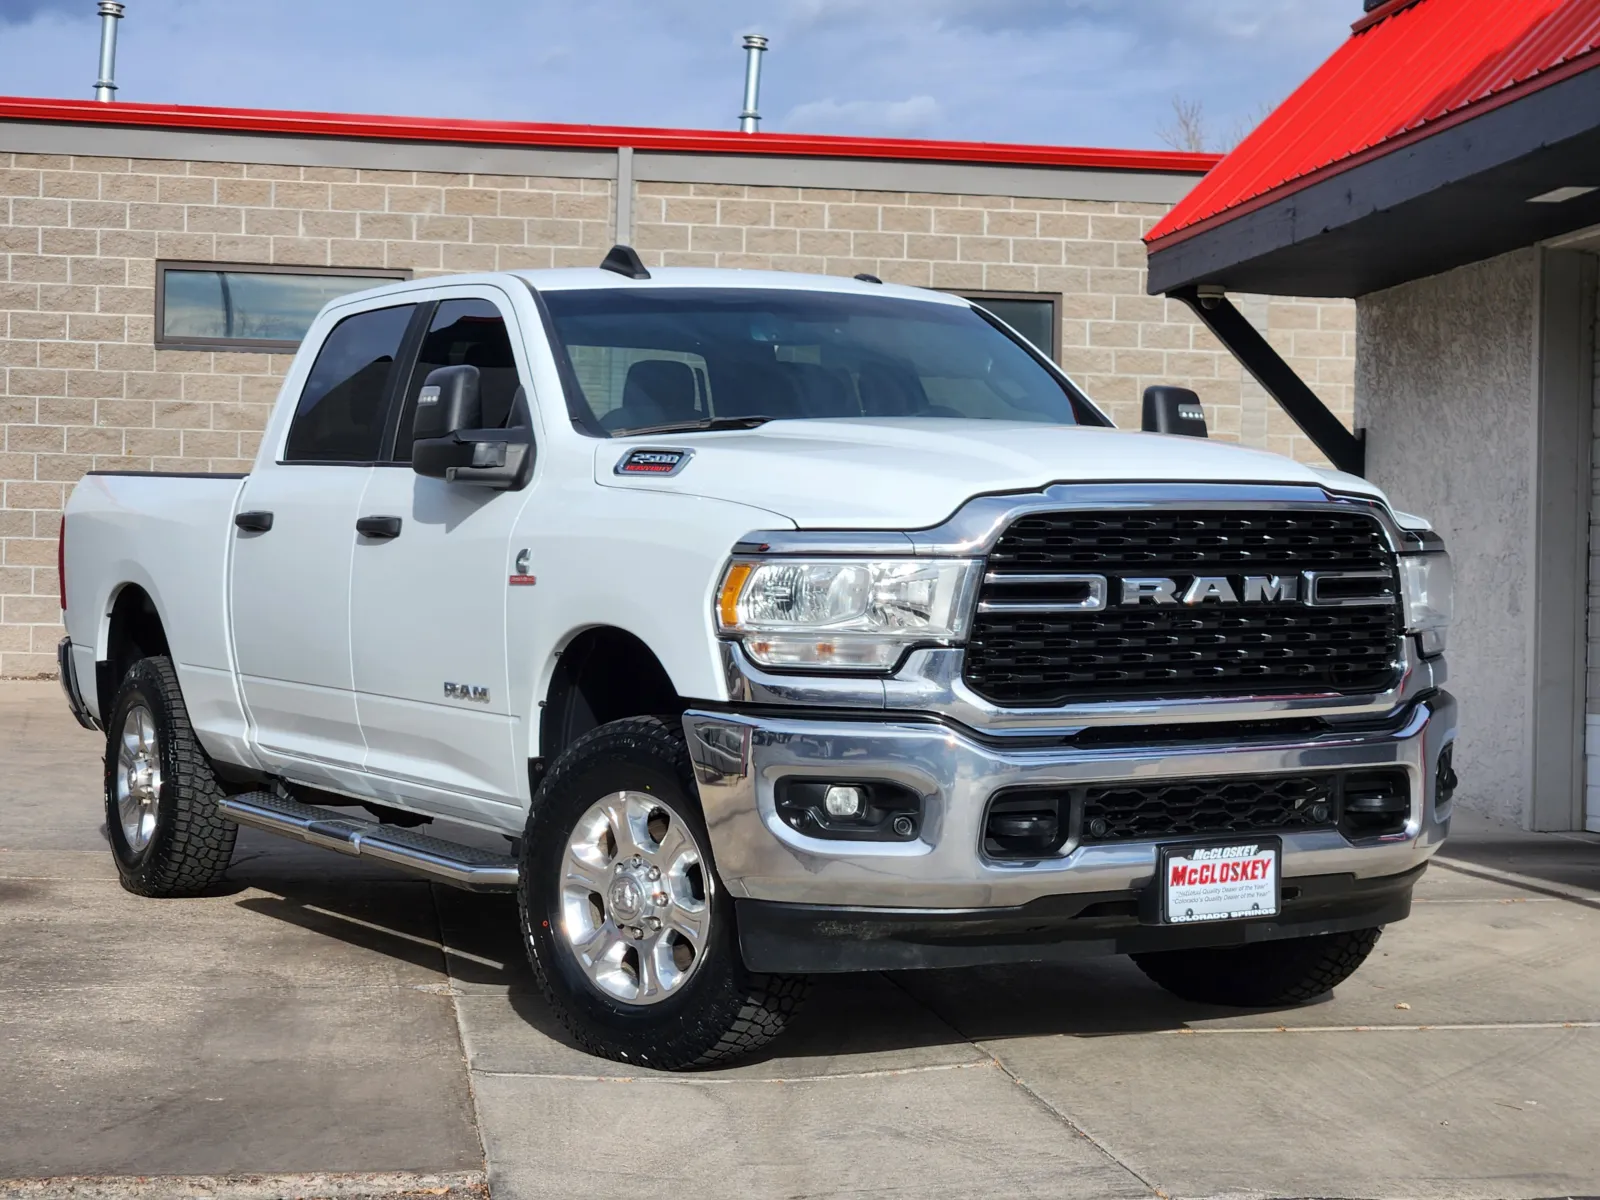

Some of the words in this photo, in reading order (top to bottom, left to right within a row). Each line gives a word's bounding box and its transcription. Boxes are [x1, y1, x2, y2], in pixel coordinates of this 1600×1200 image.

[630, 453, 680, 464] 2500
[1120, 575, 1299, 605] RAM
[443, 681, 490, 703] RAM
[1170, 912, 1228, 923] COLORADO
[1230, 908, 1276, 918] SPRINGS
